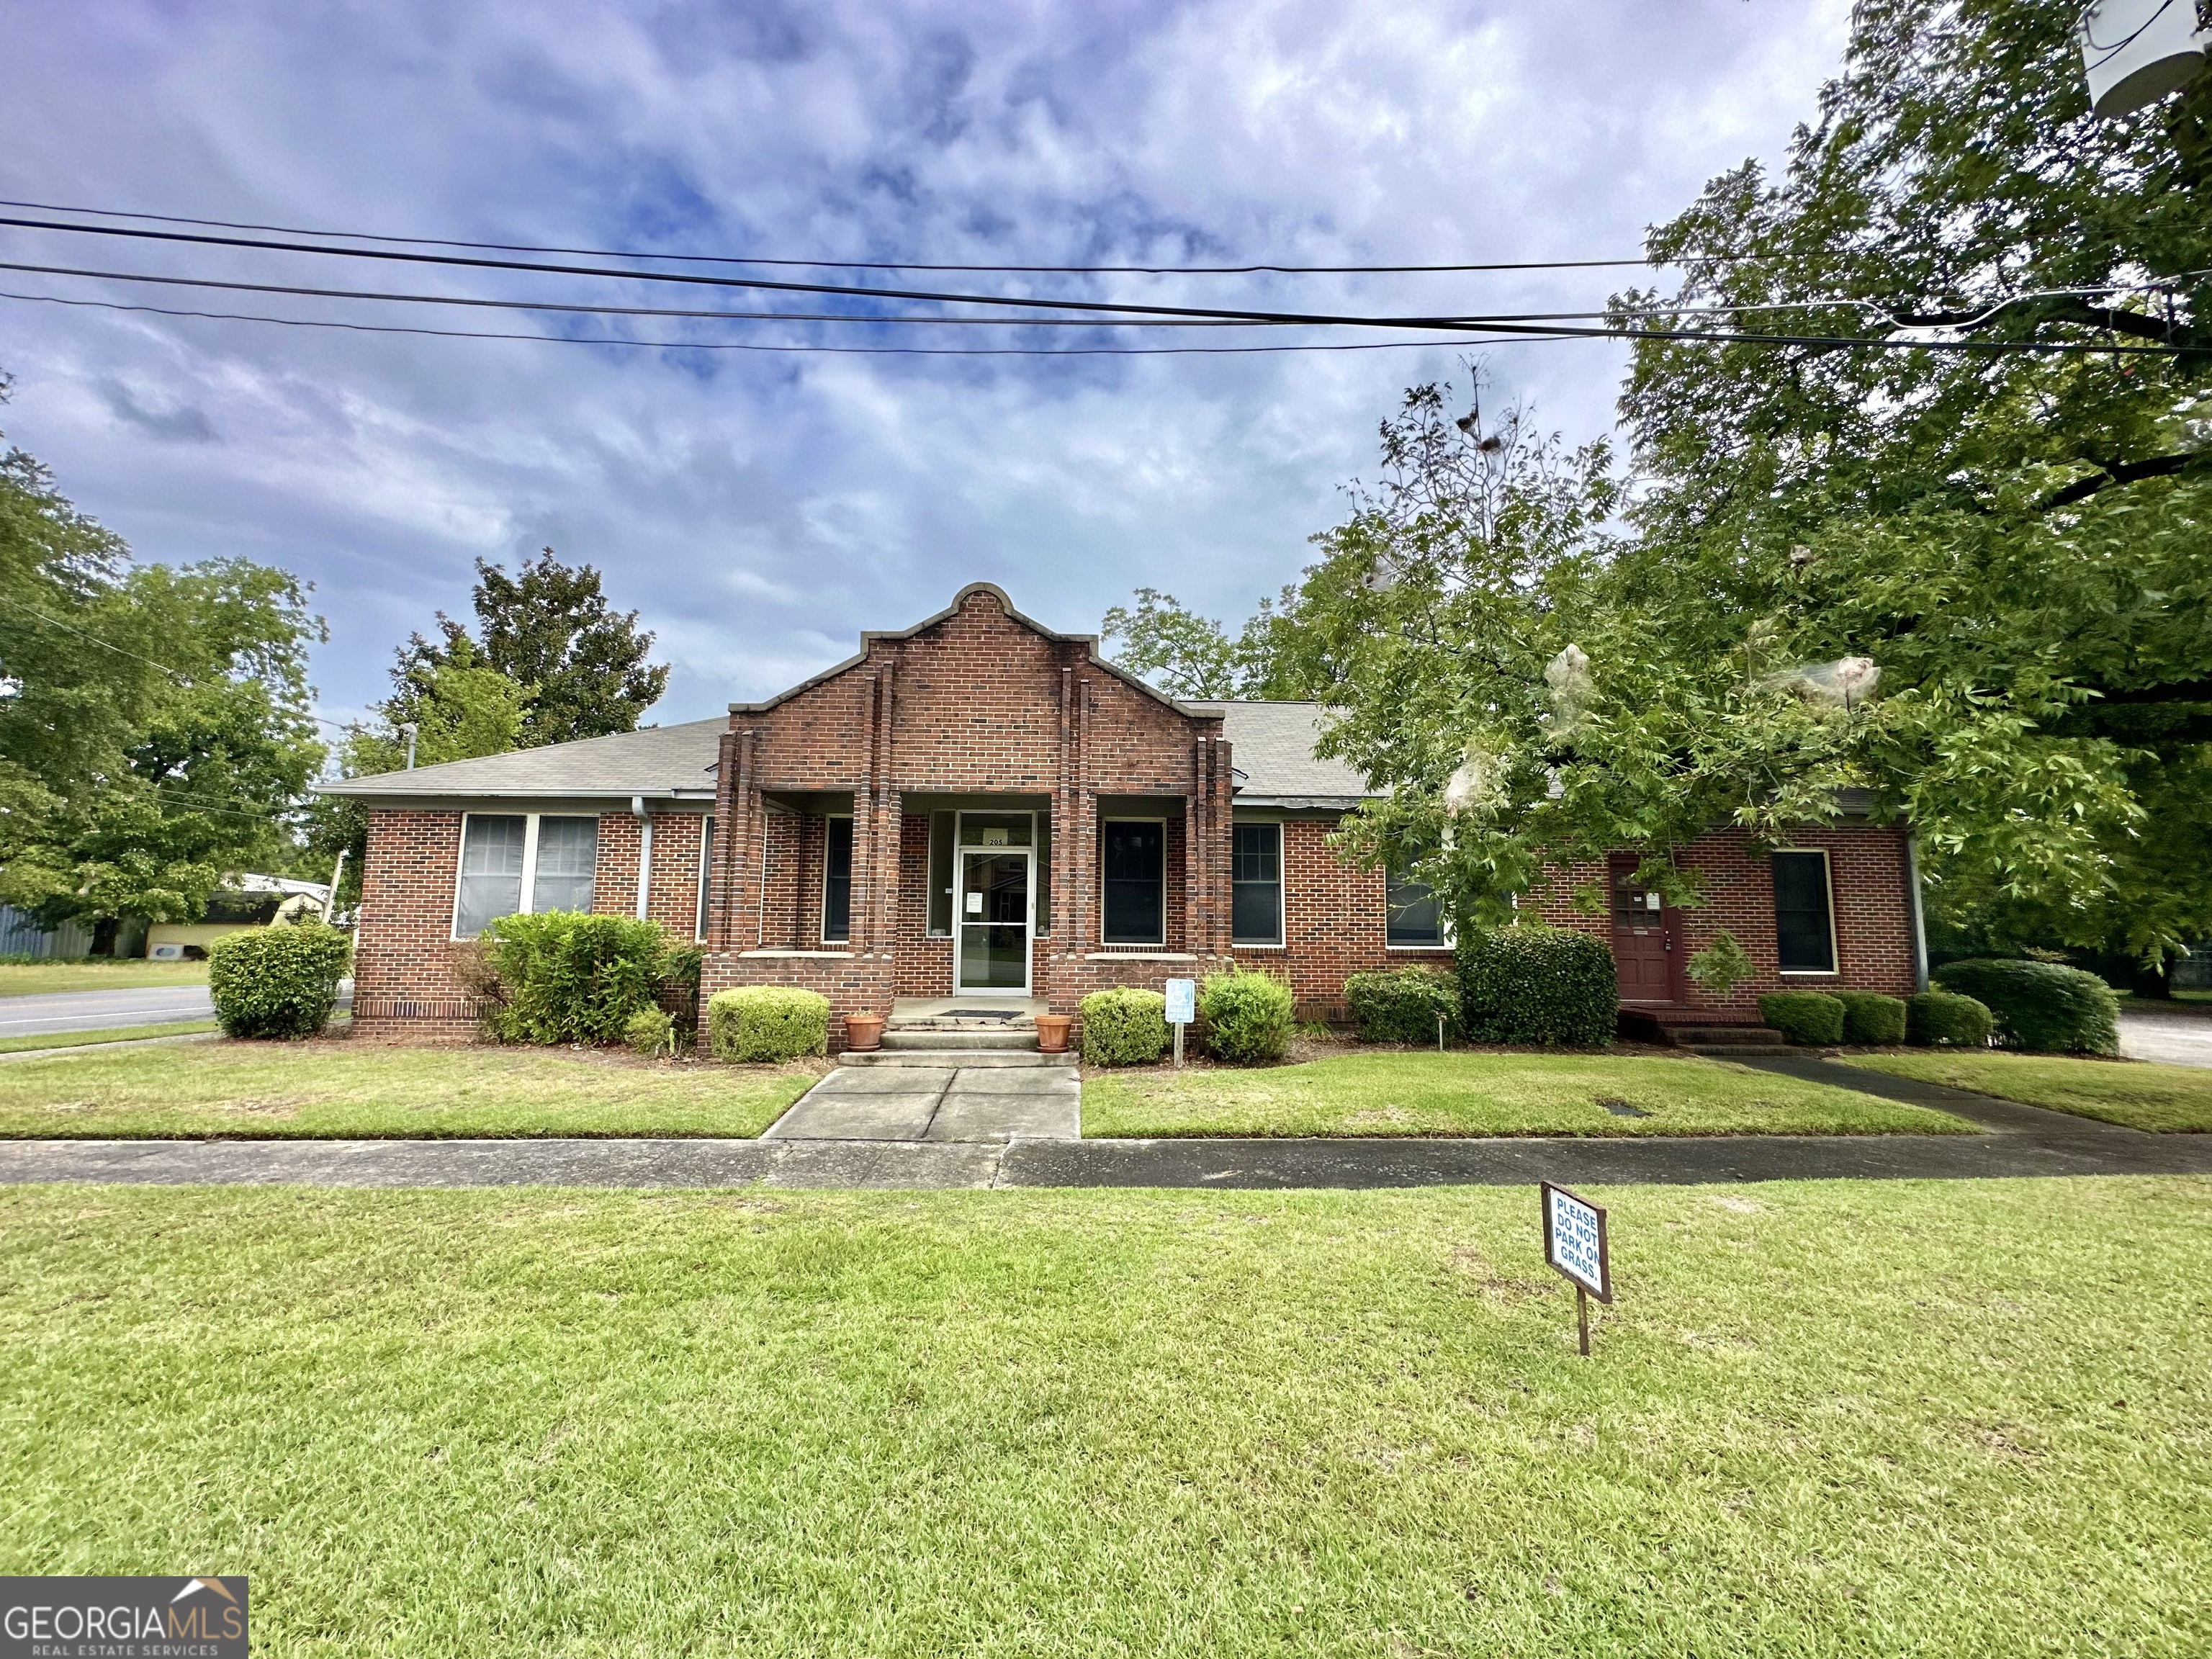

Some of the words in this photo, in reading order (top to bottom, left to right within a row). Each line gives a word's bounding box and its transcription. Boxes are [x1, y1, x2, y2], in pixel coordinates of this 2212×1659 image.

[1557, 1197, 1596, 1231] PLEASE
[1557, 1213, 1572, 1231] DO
[1575, 1223, 1597, 1247] NOT
[1555, 1226, 1583, 1254] PARK
[1586, 1246, 1601, 1267] ON
[1560, 1246, 1598, 1281] GRASS.
